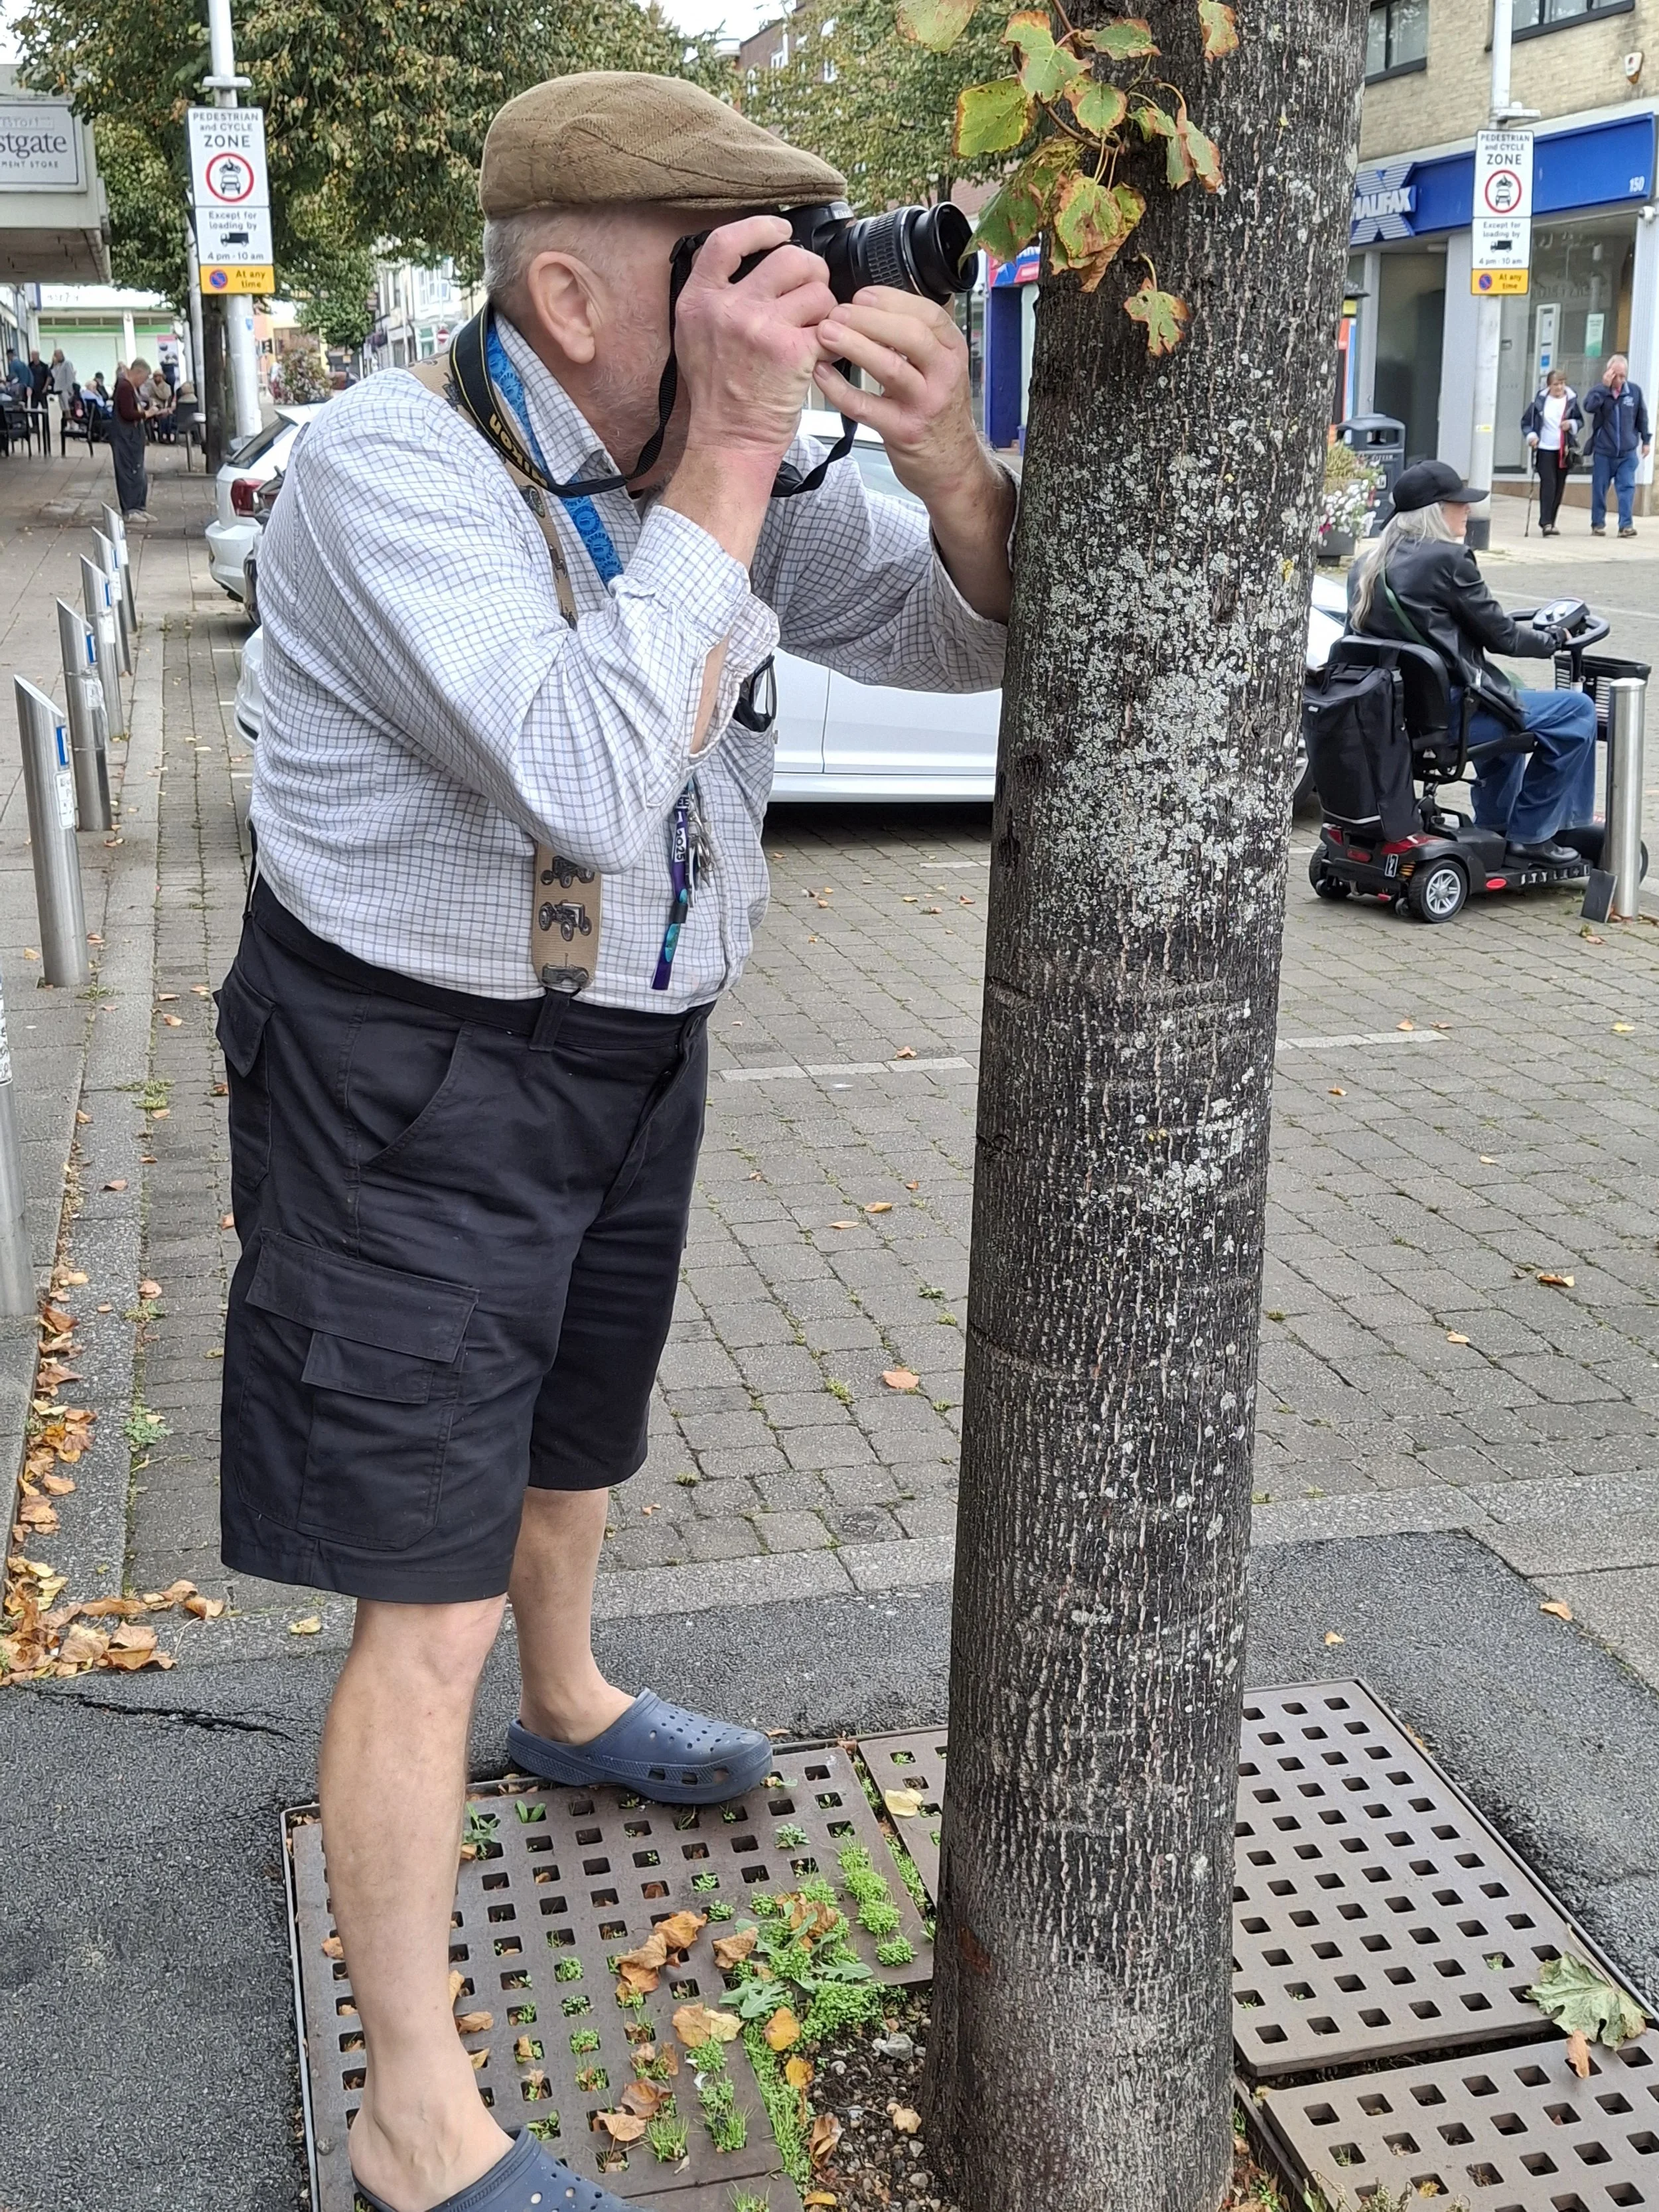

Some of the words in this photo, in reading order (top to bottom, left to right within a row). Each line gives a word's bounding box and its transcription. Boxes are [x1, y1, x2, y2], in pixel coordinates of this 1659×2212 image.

[193, 112, 258, 121] PEDESTRIAN
[220, 123, 252, 131] CYCLE
[204, 135, 250, 147] ZONE
[1486, 153, 1522, 165] ZONE
[1629, 175, 1645, 192] 150
[208, 210, 240, 220] Except
[209, 221, 243, 230] loading
[246, 222, 257, 230] by
[676, 830, 685, 861] 2025
